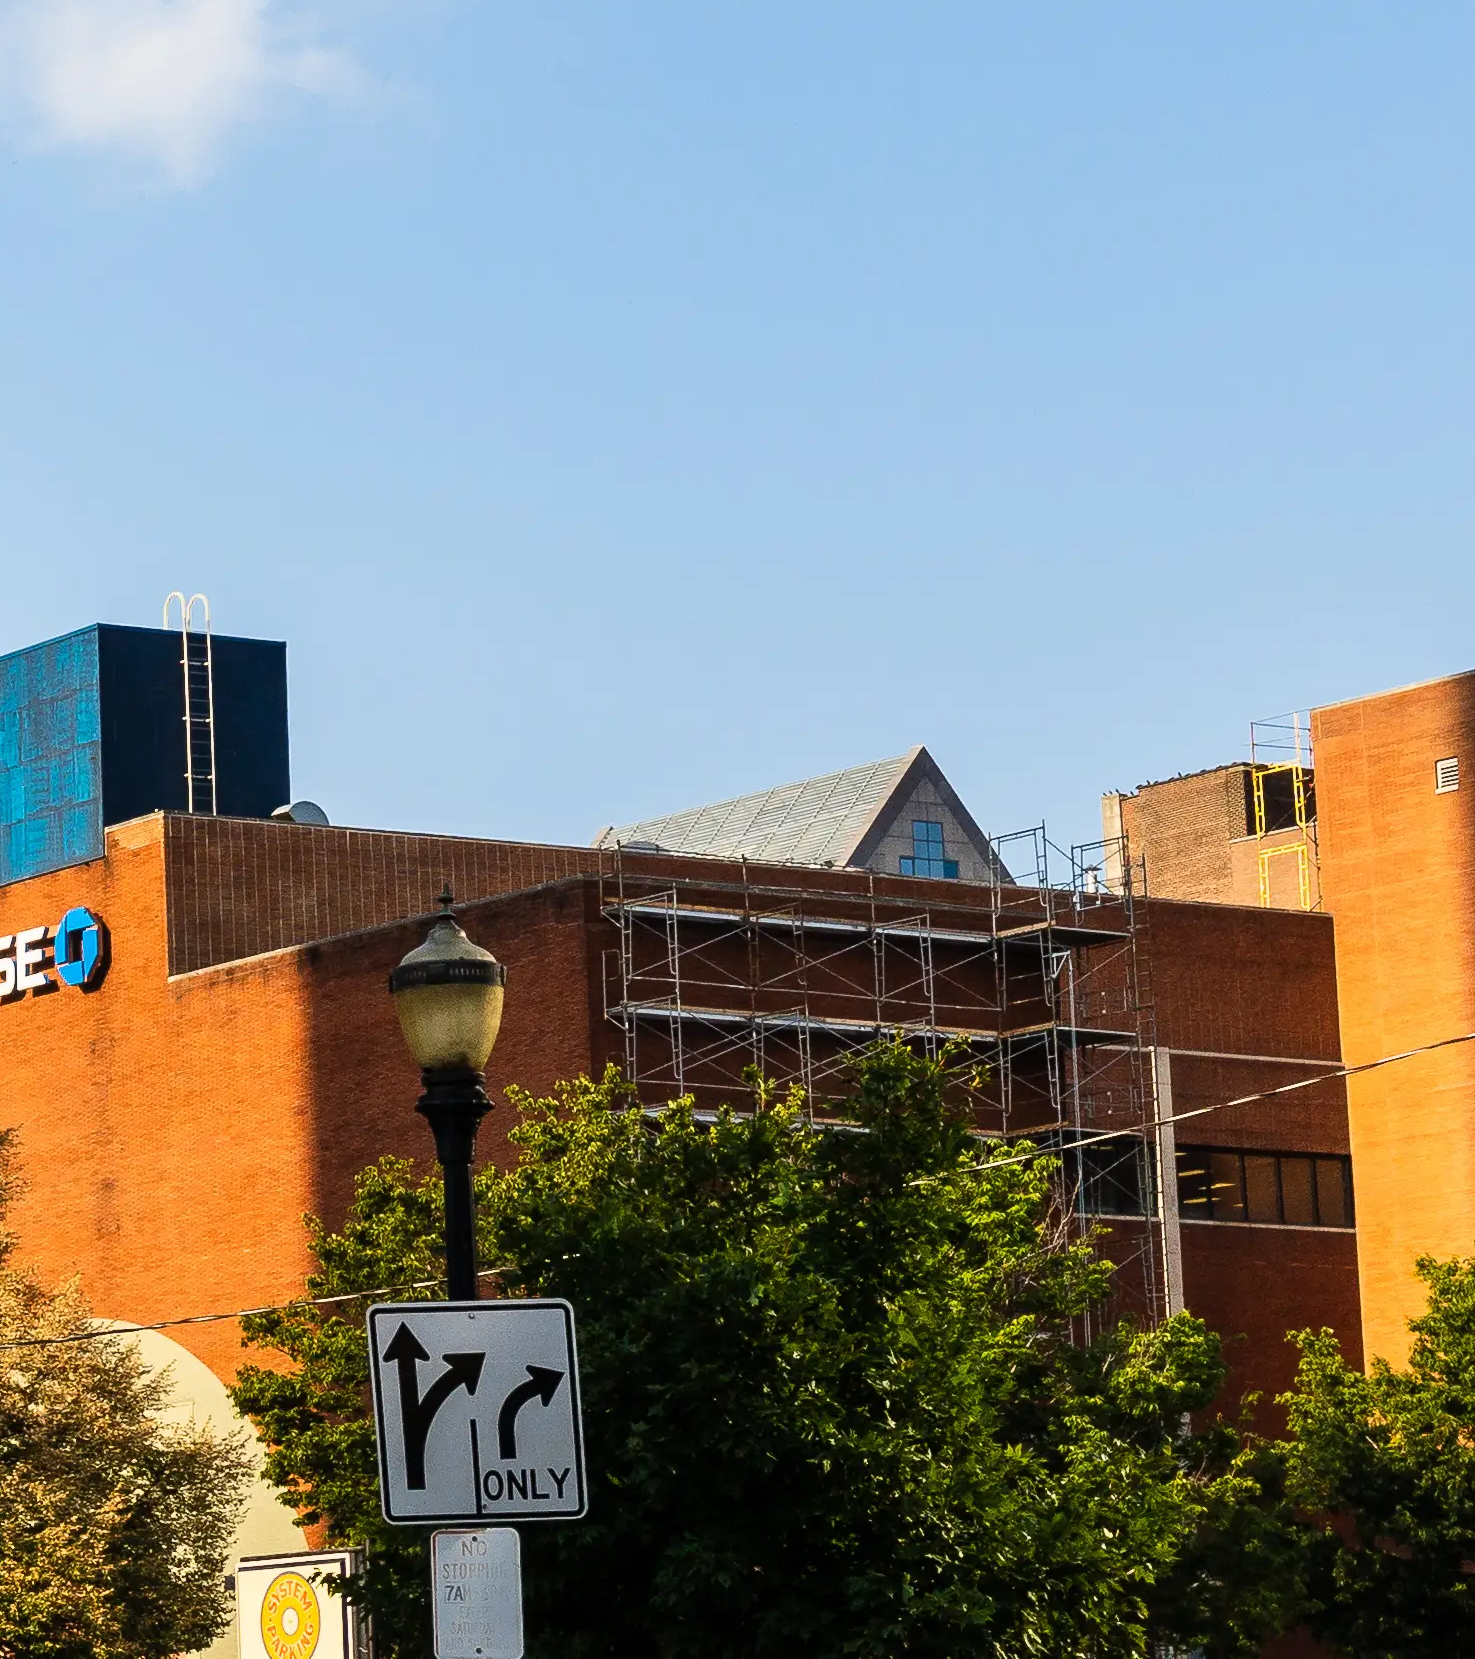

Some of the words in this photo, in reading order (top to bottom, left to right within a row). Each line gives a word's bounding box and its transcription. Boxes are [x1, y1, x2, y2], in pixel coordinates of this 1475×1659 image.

[482, 1467, 571, 1501] ONLY
[461, 1540, 487, 1556] NO
[267, 1580, 313, 1615] SYSTEM
[267, 1622, 315, 1659] PARKING
